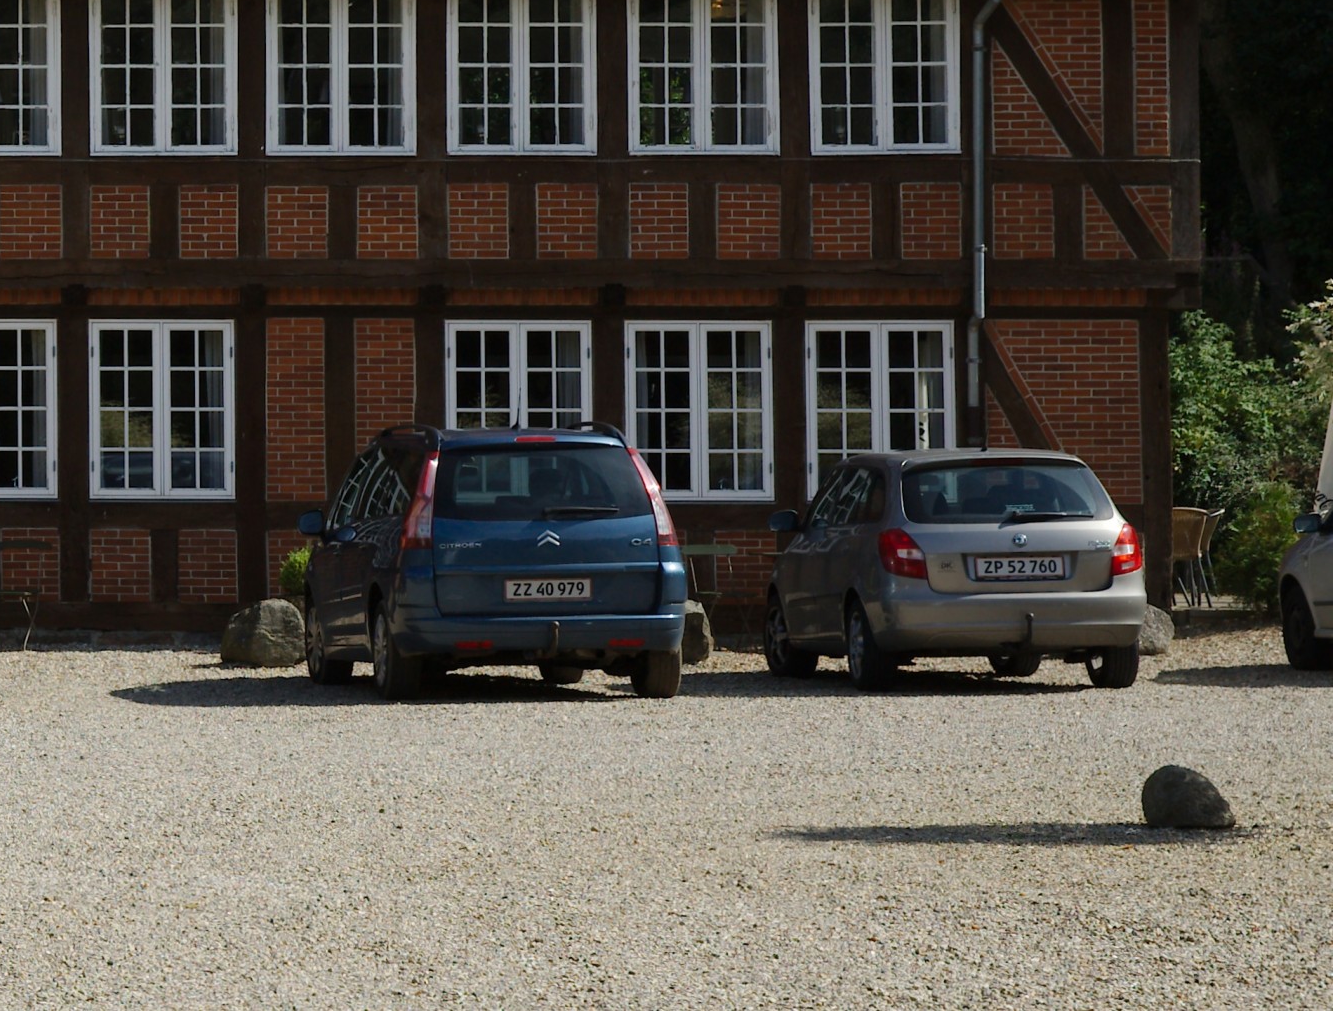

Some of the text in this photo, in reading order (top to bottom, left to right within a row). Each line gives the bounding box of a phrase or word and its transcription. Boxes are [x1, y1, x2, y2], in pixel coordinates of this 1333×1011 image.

[984, 559, 1057, 574] ZP 52 760
[513, 581, 585, 596] ZZ 40 979
